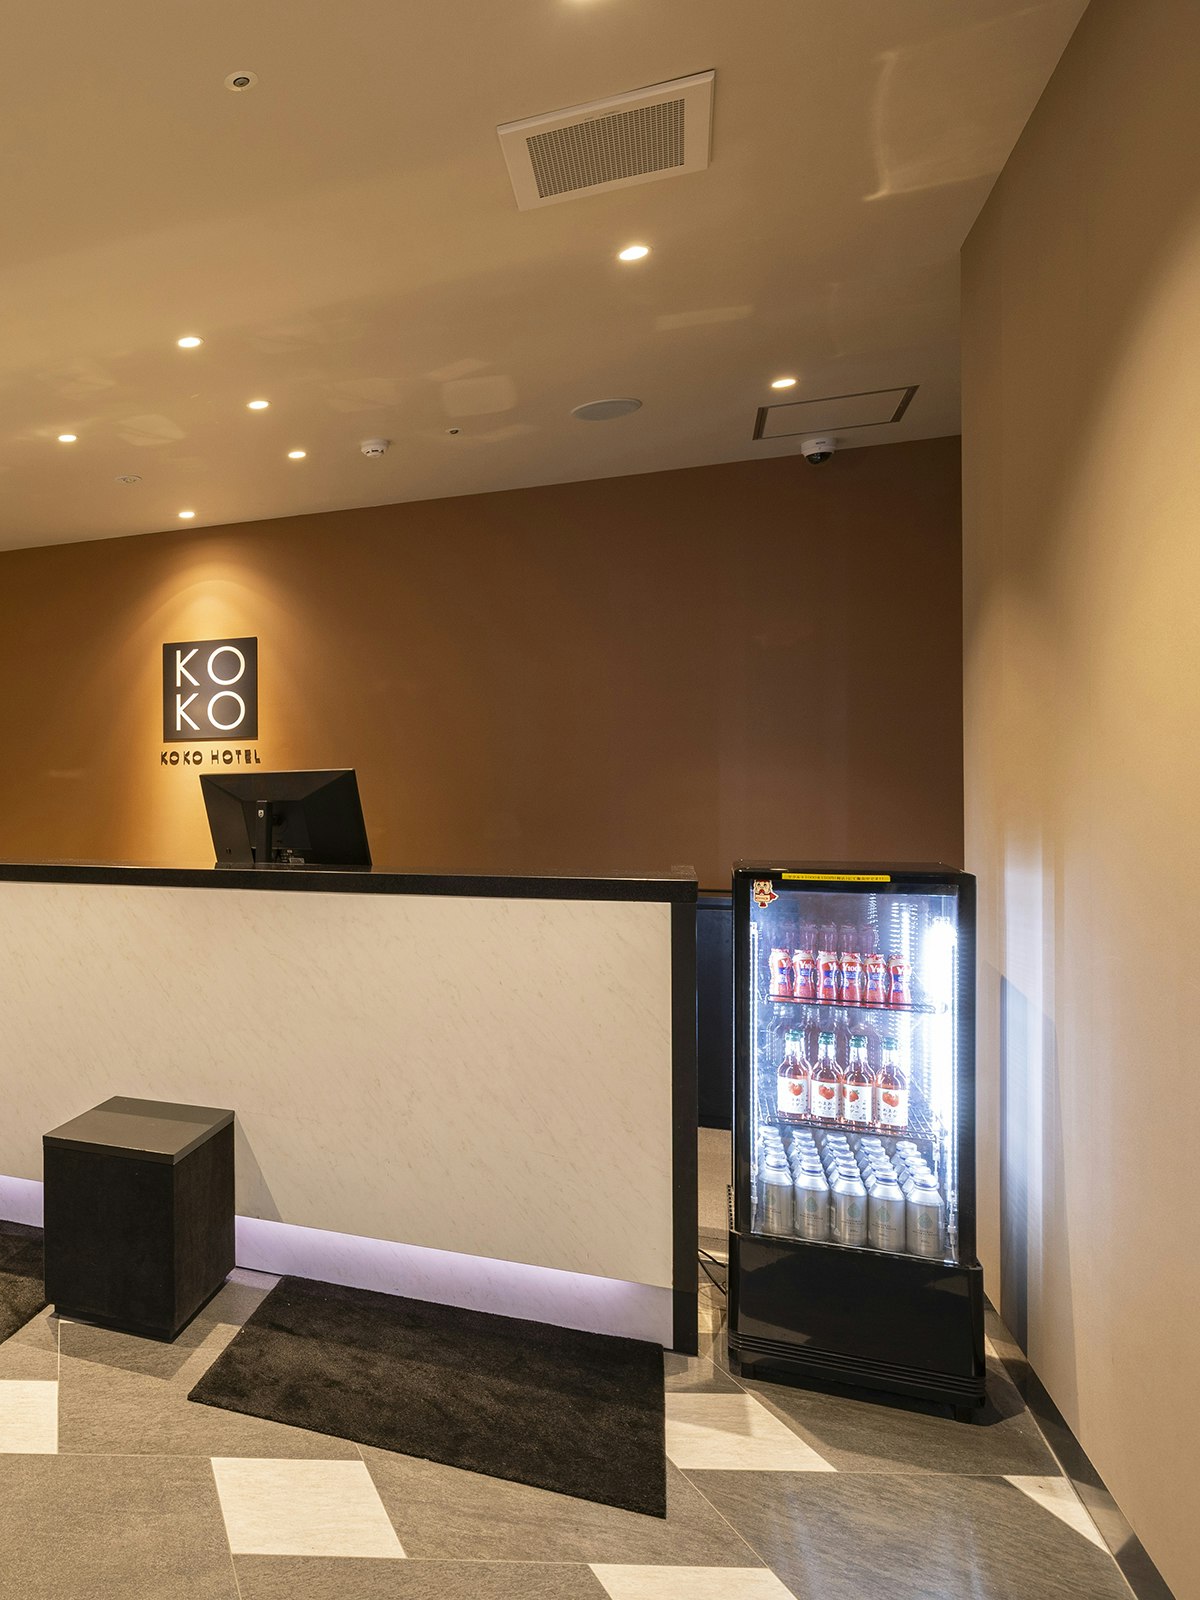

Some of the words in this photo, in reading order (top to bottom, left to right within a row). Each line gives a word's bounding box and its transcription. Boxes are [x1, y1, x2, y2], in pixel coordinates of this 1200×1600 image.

[175, 645, 246, 688] KO
[175, 690, 246, 732] KO
[160, 750, 203, 766] KOKO
[210, 749, 261, 765] HOTEL
